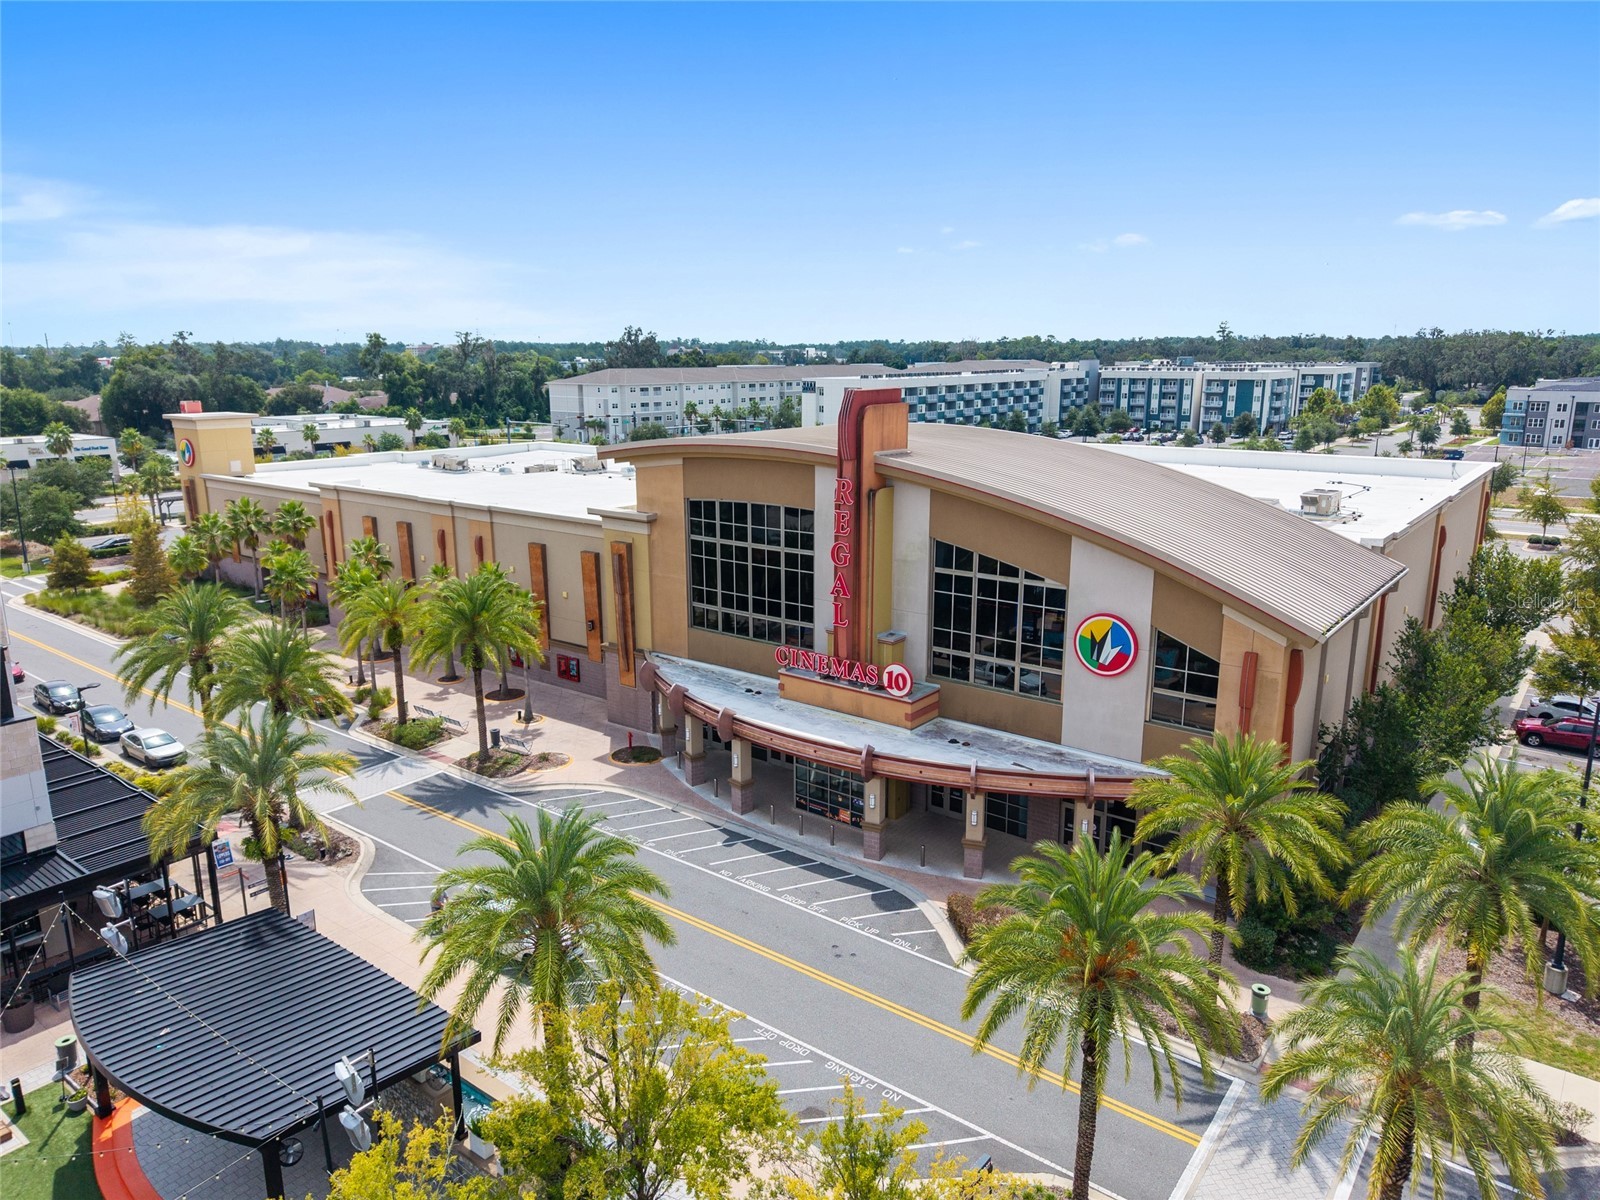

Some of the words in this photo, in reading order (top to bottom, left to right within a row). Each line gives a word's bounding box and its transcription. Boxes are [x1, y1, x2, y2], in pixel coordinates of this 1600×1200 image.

[830, 478, 854, 627] REGAL
[775, 646, 878, 686] CINEMAS
[885, 670, 907, 692] 10
[719, 869, 733, 877] NO
[735, 876, 771, 893] PARKING
[781, 893, 807, 905] DROP
[807, 904, 828, 914] OFF
[839, 916, 863, 929] PICK
[864, 927, 881, 935] UP
[893, 937, 922, 951] ONLY
[753, 1027, 778, 1040] OFF
[778, 1040, 811, 1057] DROP
[825, 1061, 878, 1090] PARKING
[881, 1089, 902, 1102] NO
